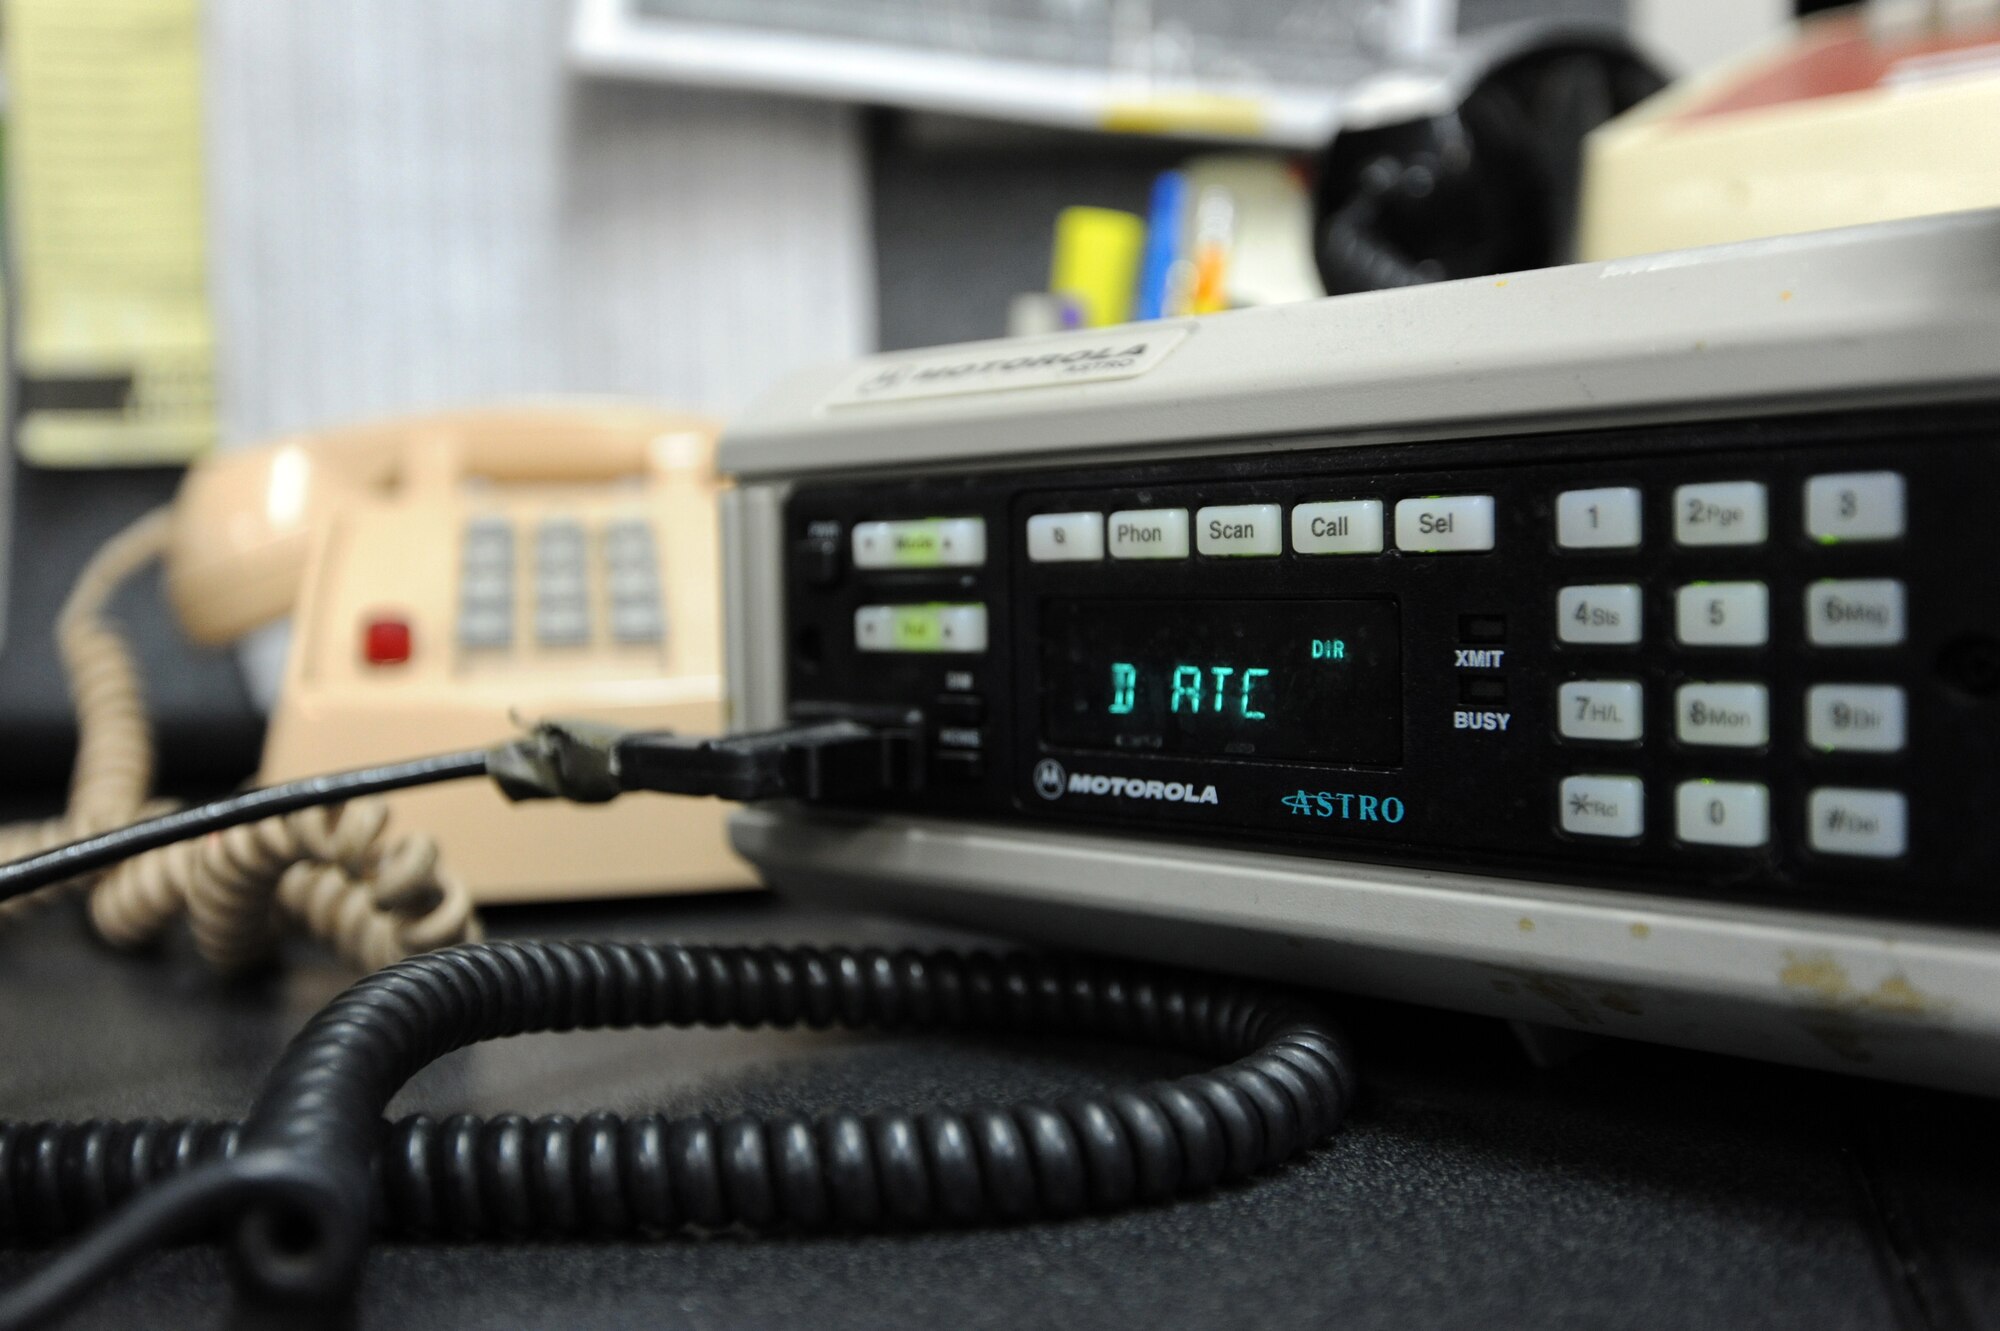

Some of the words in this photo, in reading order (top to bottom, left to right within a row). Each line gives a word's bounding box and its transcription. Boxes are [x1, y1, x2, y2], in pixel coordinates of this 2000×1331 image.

[1310, 516, 1349, 538] Call
[1418, 513, 1454, 534] Sel
[1588, 506, 1599, 528] 1
[1117, 525, 1162, 544] Phon
[1209, 520, 1255, 541] Scan
[1709, 600, 1724, 626] 5
[1311, 639, 1345, 659] DIR
[1454, 650, 1504, 669] XMIT
[1108, 662, 1138, 716] D
[1170, 665, 1270, 720] ATC
[1453, 711, 1511, 732] BUSY
[1068, 773, 1219, 806] MOTOROLA
[1280, 788, 1405, 825] ASTRO
[1708, 800, 1724, 827] 0
